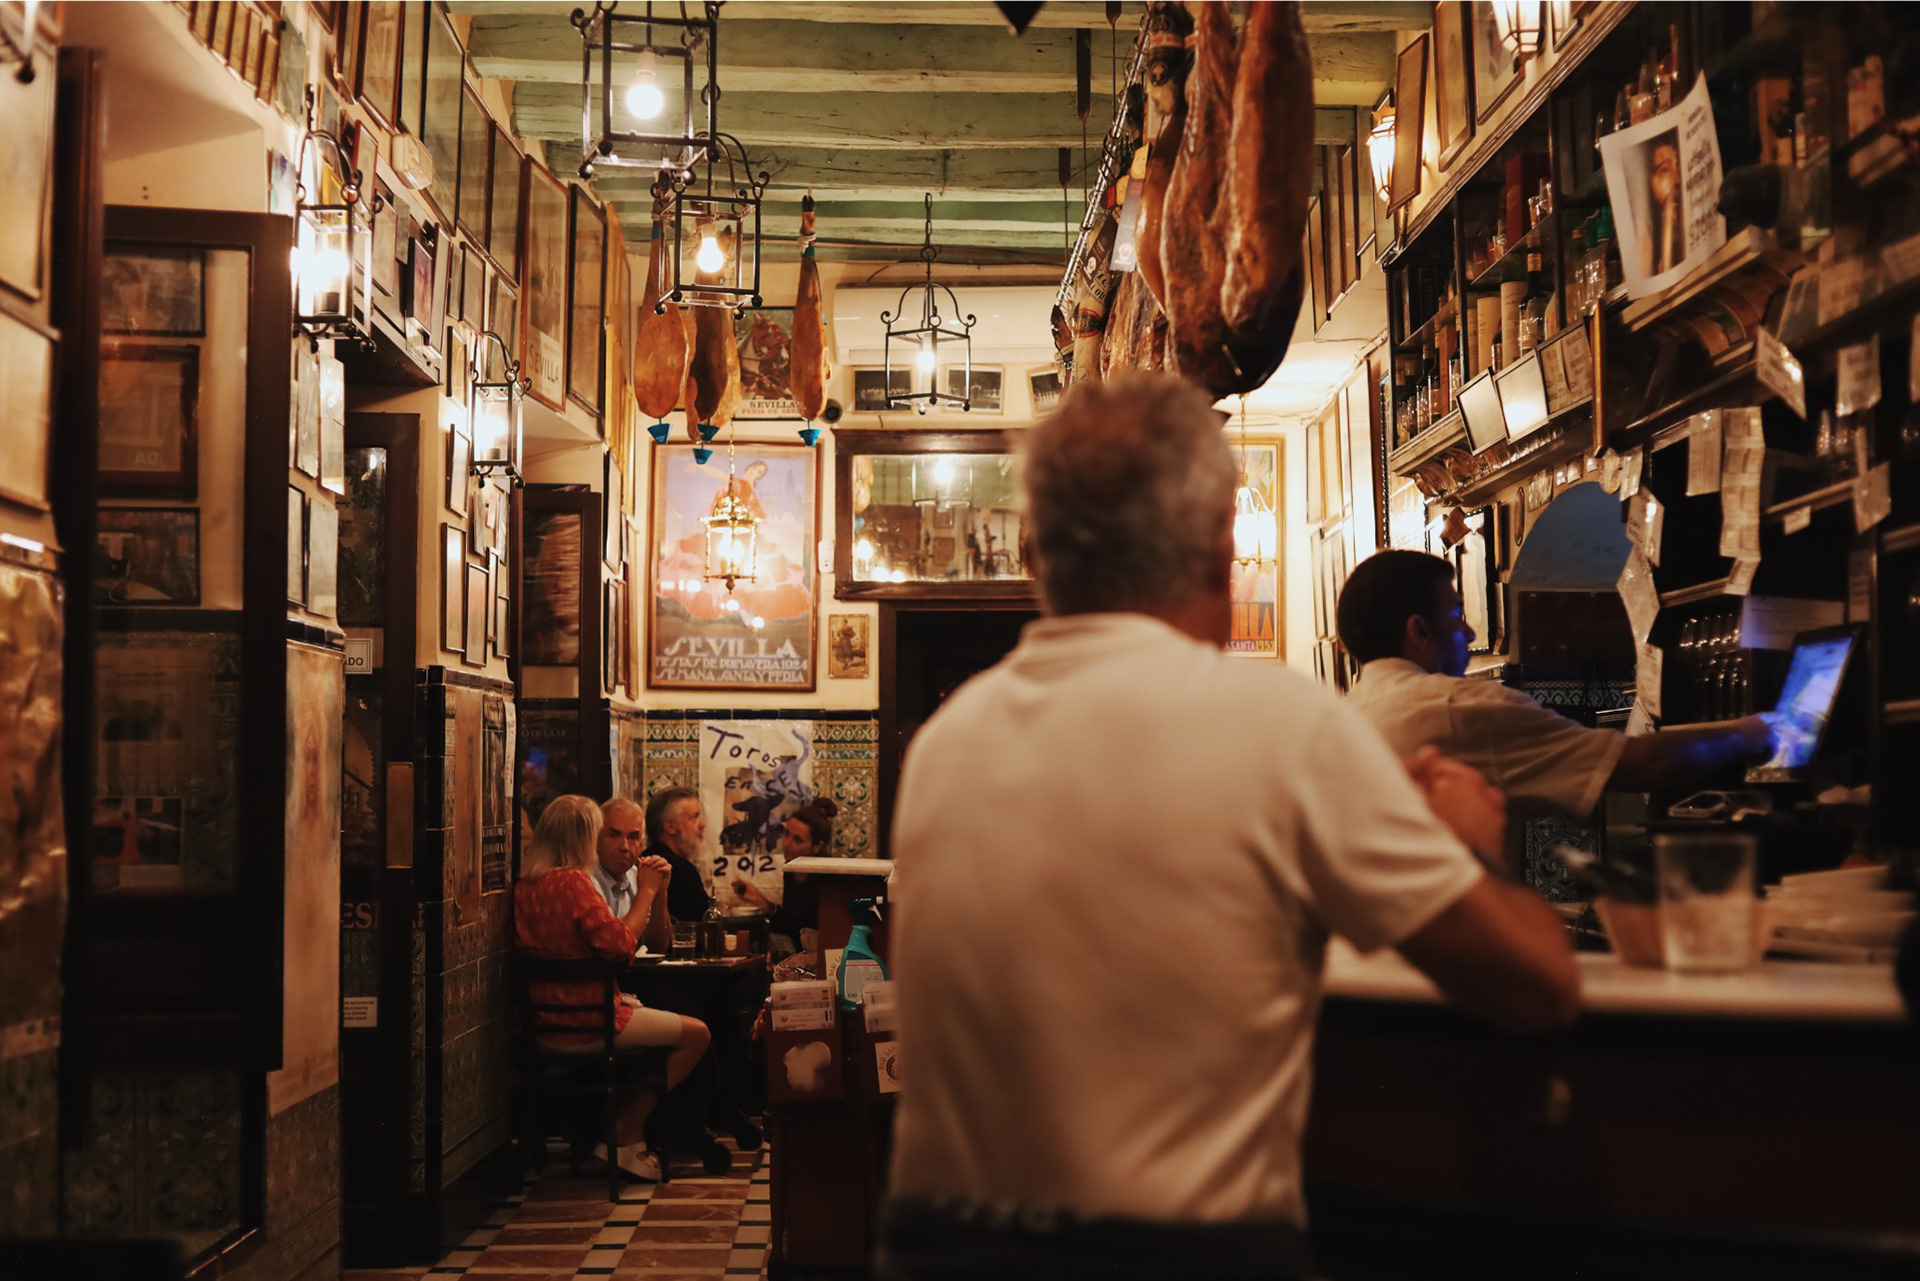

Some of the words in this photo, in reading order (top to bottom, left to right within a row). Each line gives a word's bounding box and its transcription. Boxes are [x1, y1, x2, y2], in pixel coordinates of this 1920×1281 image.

[529, 343, 559, 384] SEVILLA
[1231, 603, 1274, 640] ILLA
[664, 636, 800, 659] SEVILLA
[656, 668, 716, 681] SEMANA
[718, 669, 755, 683] SANTA
[768, 670, 805, 683] FERIA
[703, 657, 718, 669] DE
[720, 657, 780, 670] PRIMAVERA
[781, 659, 808, 671] 1924
[707, 726, 781, 767] Toros
